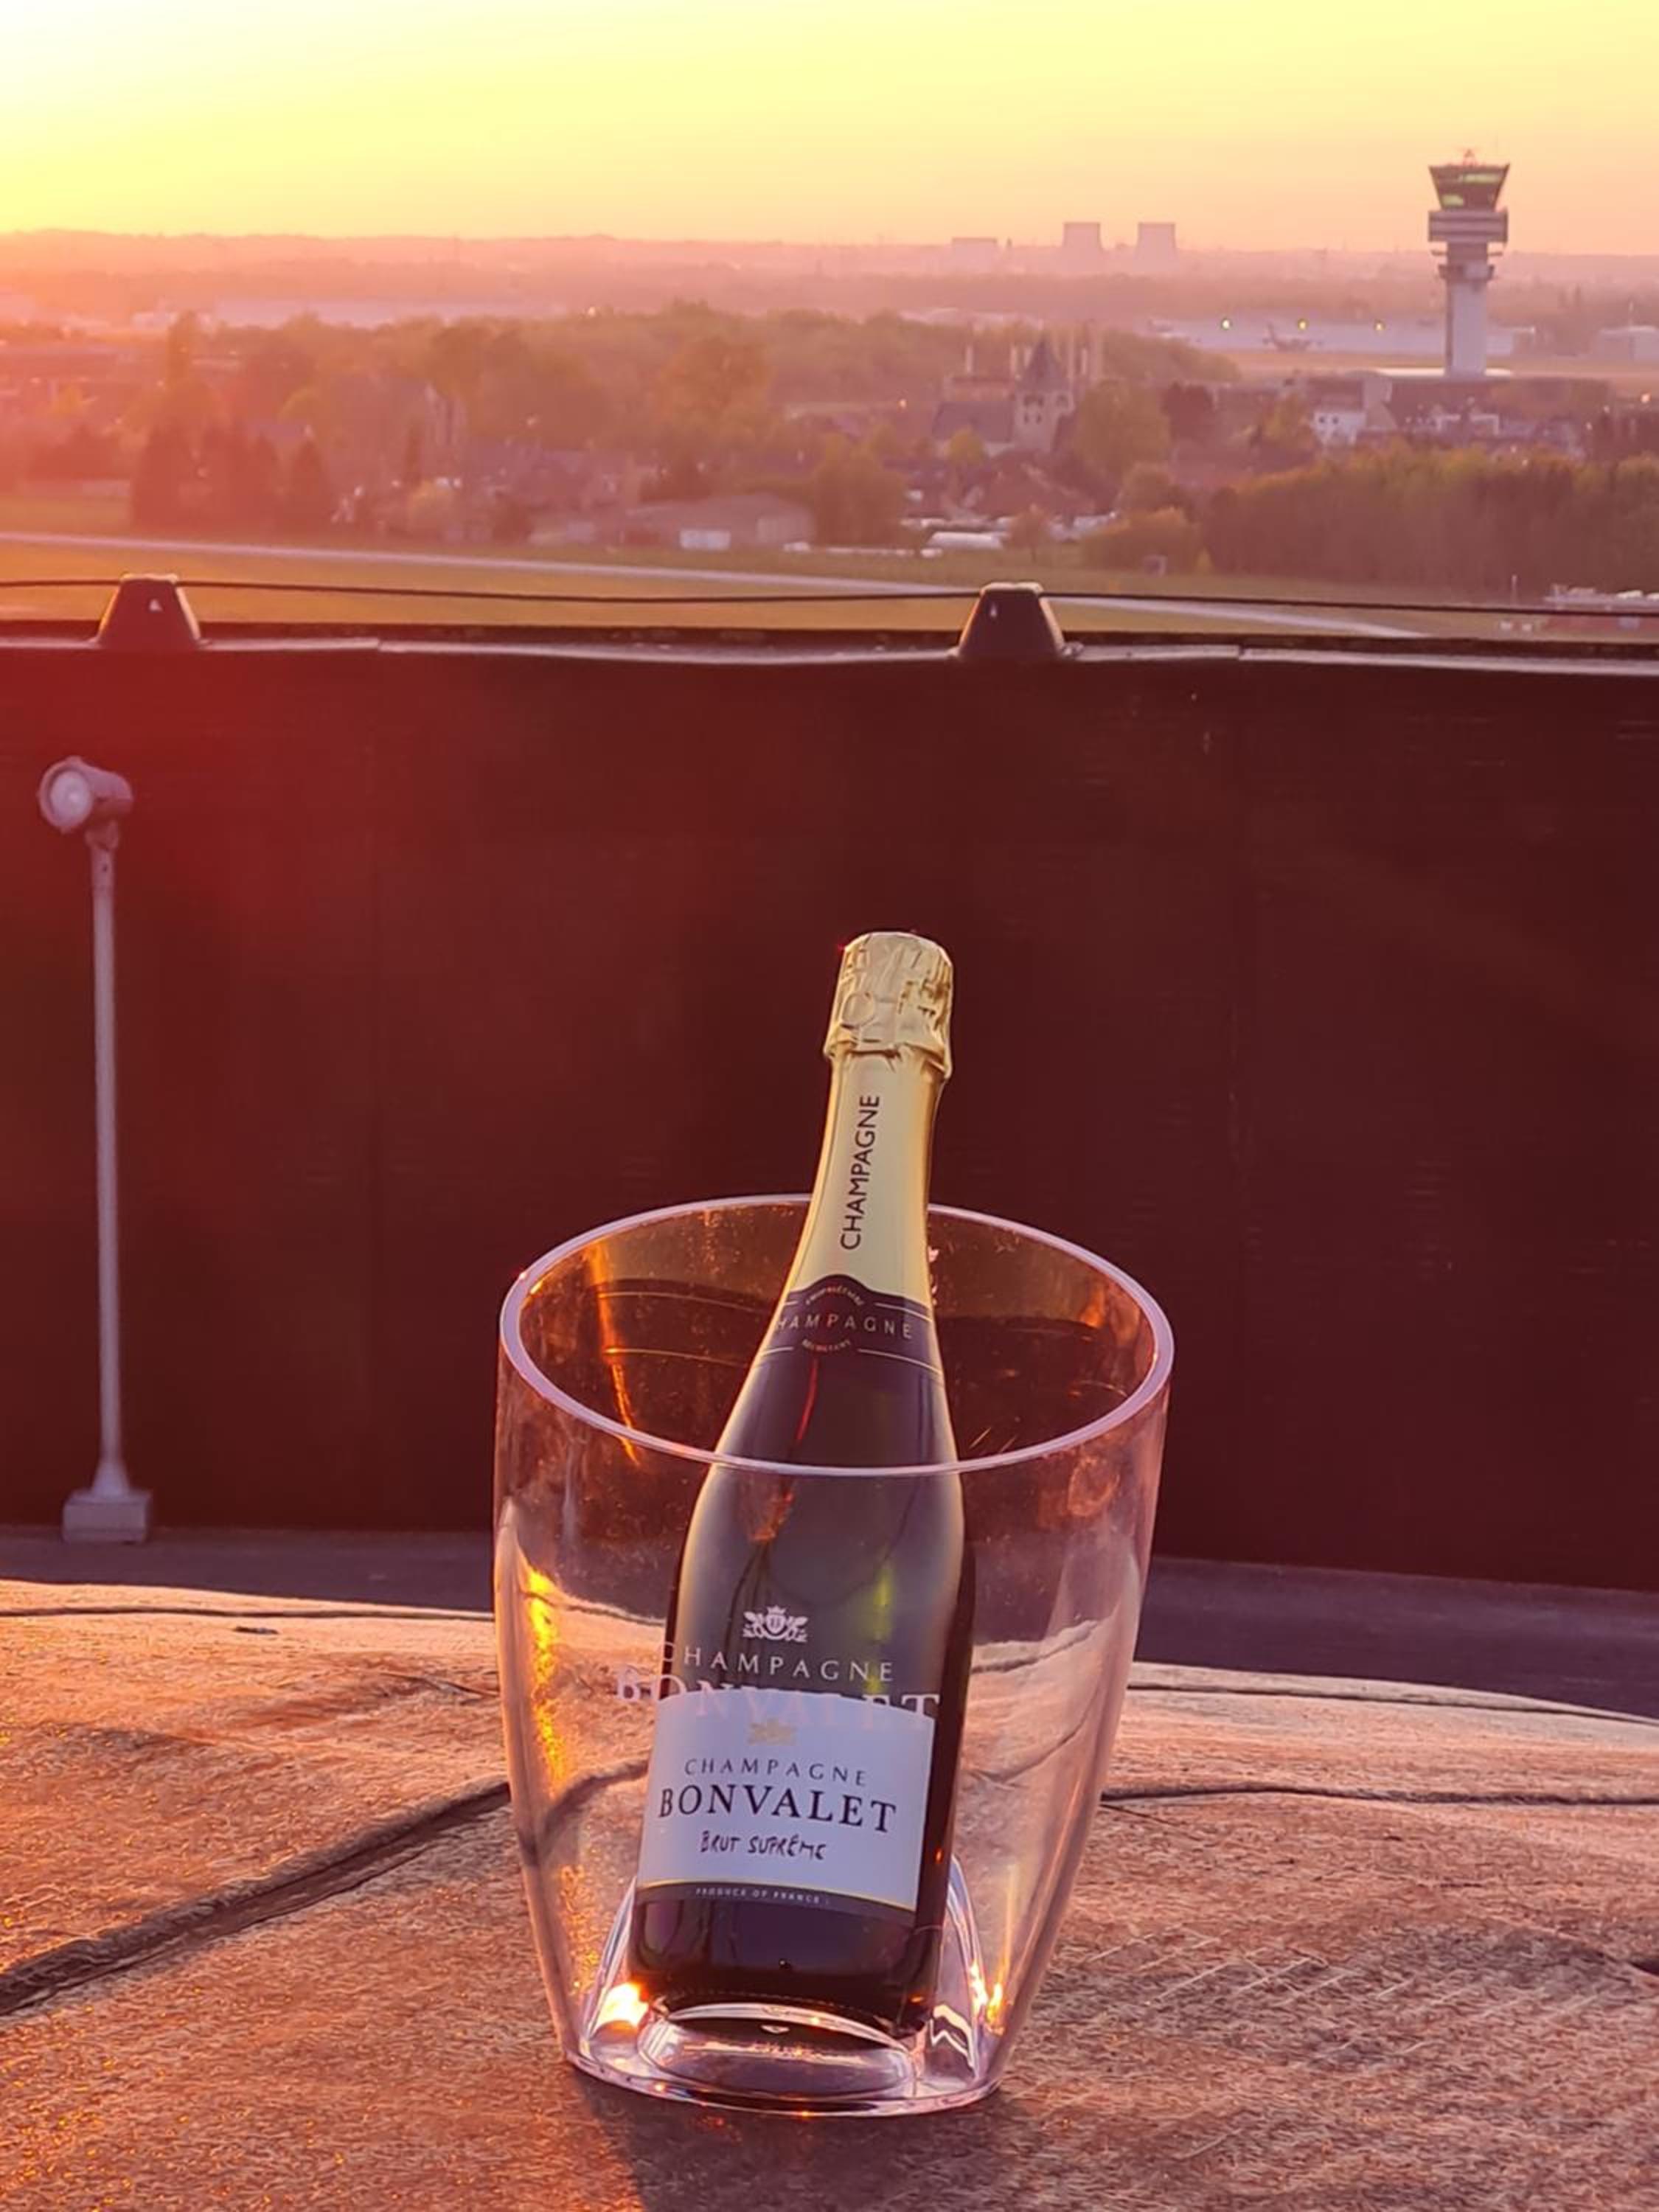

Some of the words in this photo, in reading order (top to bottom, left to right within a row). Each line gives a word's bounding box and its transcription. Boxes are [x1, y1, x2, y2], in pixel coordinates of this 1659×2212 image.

[840, 1095, 880, 1251] CHAMPAGNE
[774, 1312, 913, 1340] HAMPAGNE
[656, 1641, 894, 1682] CHAMPAGNE
[684, 1758, 866, 1787] CHAMPAGNE
[658, 1784, 897, 1833] BONVALET
[700, 1830, 741, 1853] BRUT
